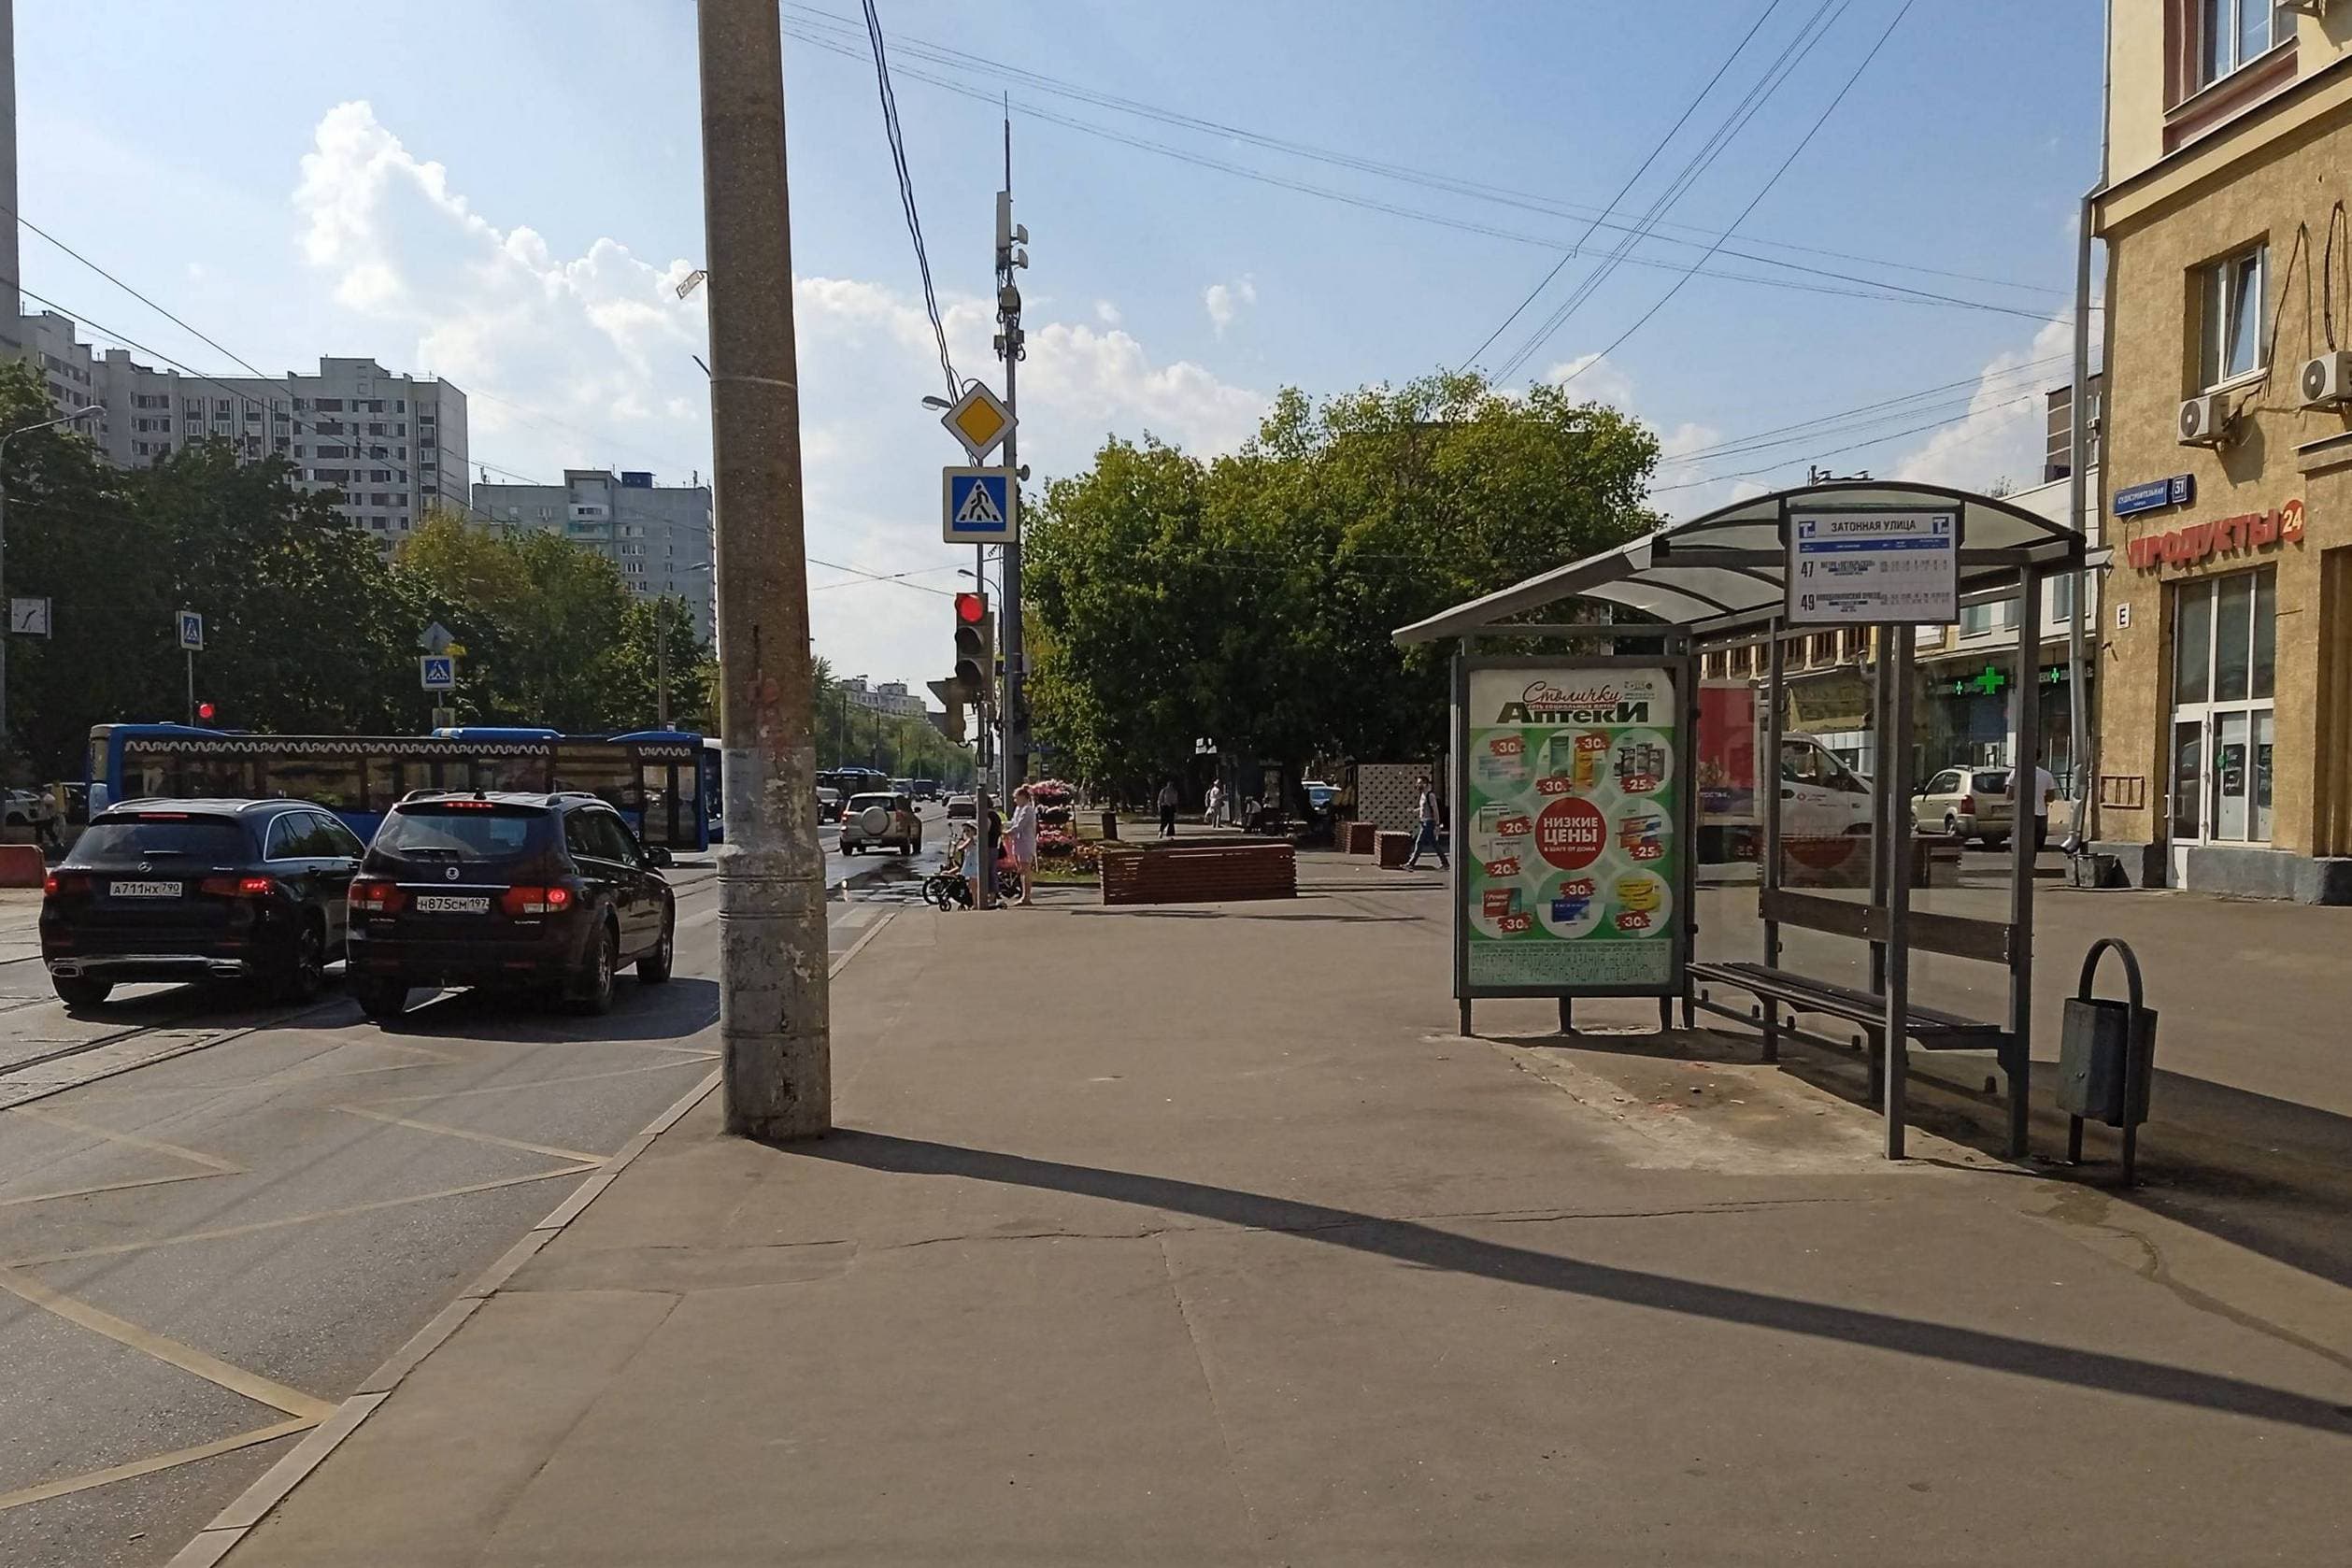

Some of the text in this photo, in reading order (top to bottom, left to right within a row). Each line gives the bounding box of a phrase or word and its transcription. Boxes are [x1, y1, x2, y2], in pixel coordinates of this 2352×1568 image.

[1831, 520, 1917, 533] ЗАТОННАЯ УЛИЦА
[2128, 507, 2303, 569] ПРОДУКТЫ 24
[1801, 561, 1814, 577] 47
[1801, 593, 1815, 611] 49
[1522, 680, 1622, 704] Столички
[1544, 817, 1599, 828] НИЗКИЕ
[1544, 829, 1598, 845] ЦЕНЫ
[112, 882, 179, 895] А711НХ 790
[420, 898, 487, 910] Н875СМ 197
